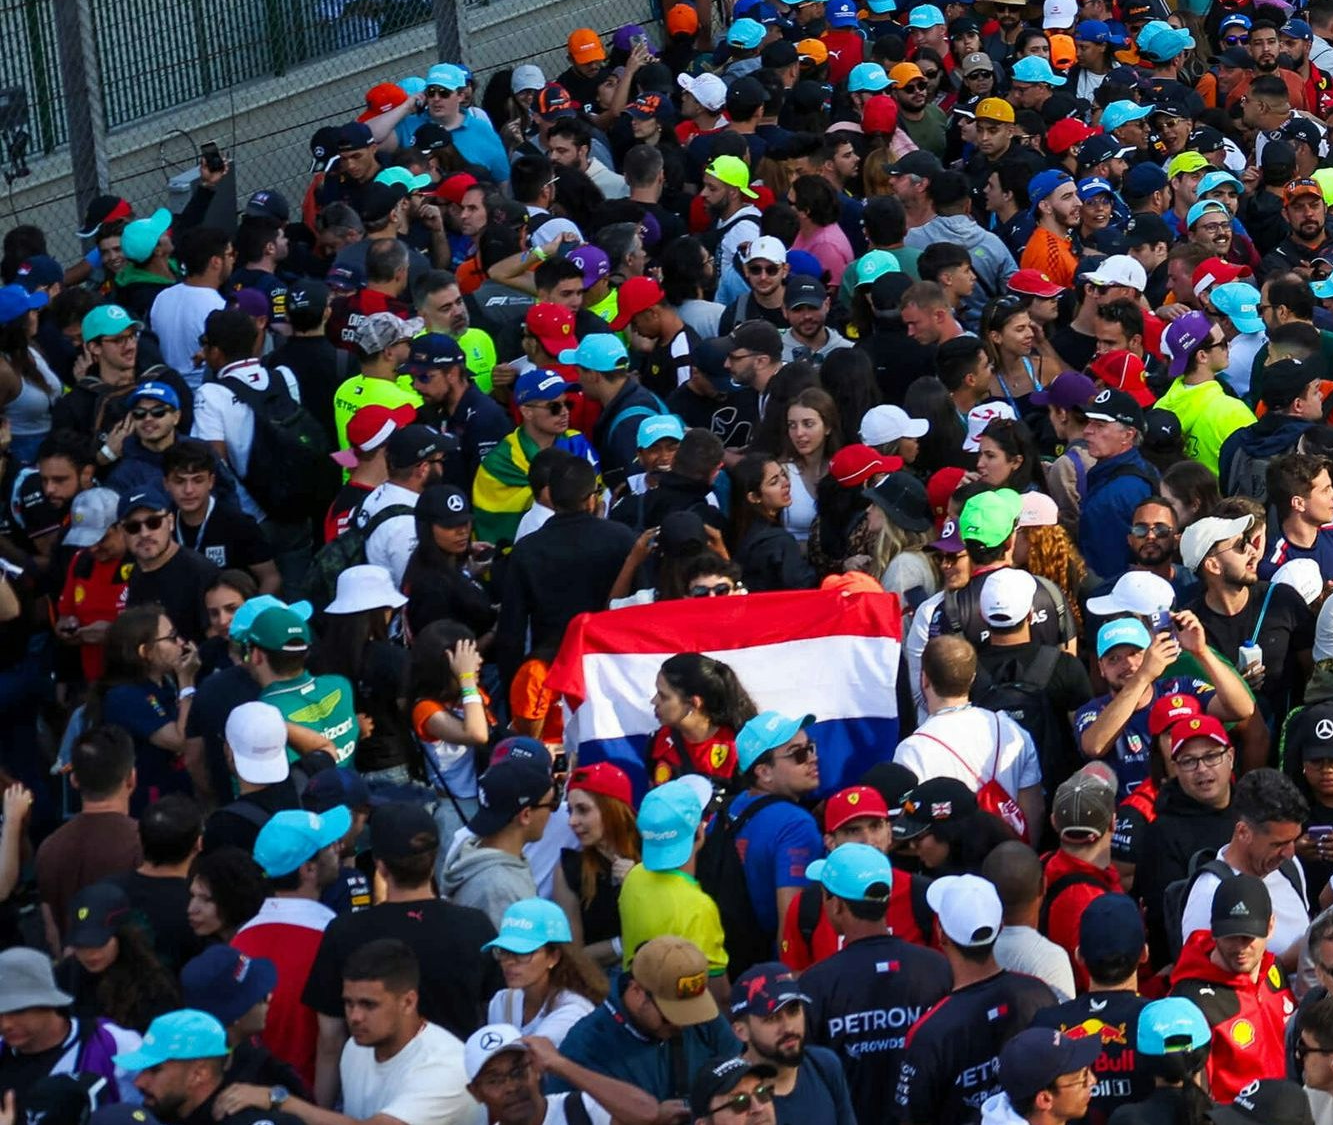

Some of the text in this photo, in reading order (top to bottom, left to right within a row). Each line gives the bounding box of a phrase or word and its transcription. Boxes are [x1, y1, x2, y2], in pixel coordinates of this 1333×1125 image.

[829, 1004, 930, 1039] PETRON
[852, 1035, 907, 1055] CROWDS
[1095, 1049, 1135, 1073] Bull
